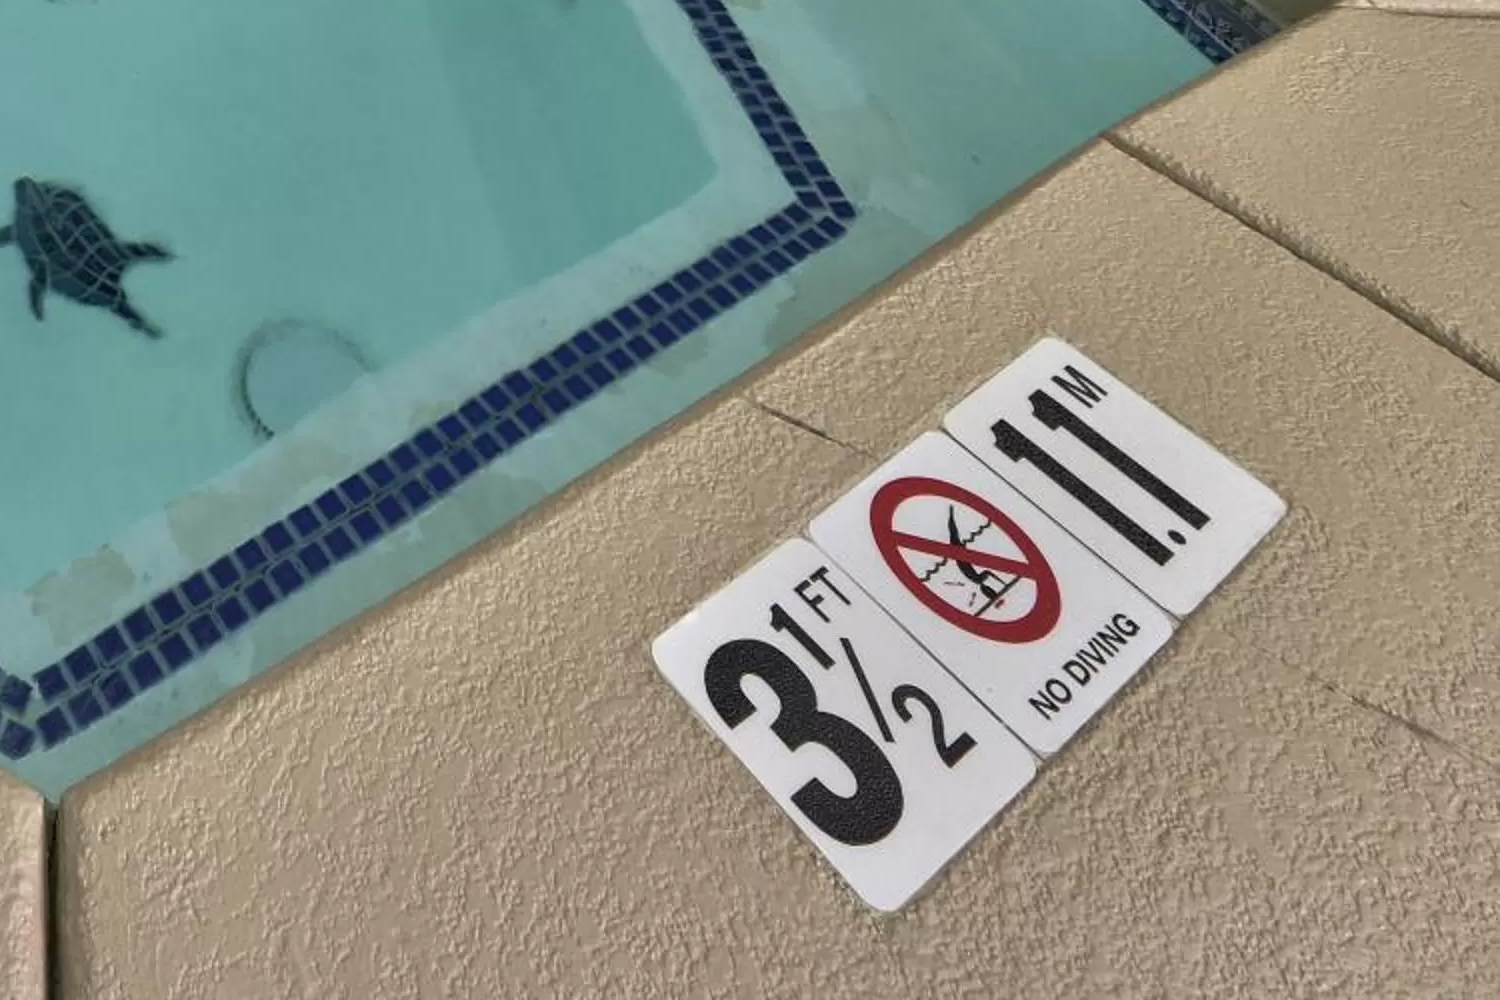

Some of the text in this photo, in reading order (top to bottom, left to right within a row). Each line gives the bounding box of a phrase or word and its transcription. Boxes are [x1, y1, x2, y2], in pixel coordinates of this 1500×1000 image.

[989, 364, 1211, 566] 1.1 M
[793, 565, 852, 623] FT
[1027, 611, 1142, 721] NO DIVING
[703, 637, 904, 847] 3
